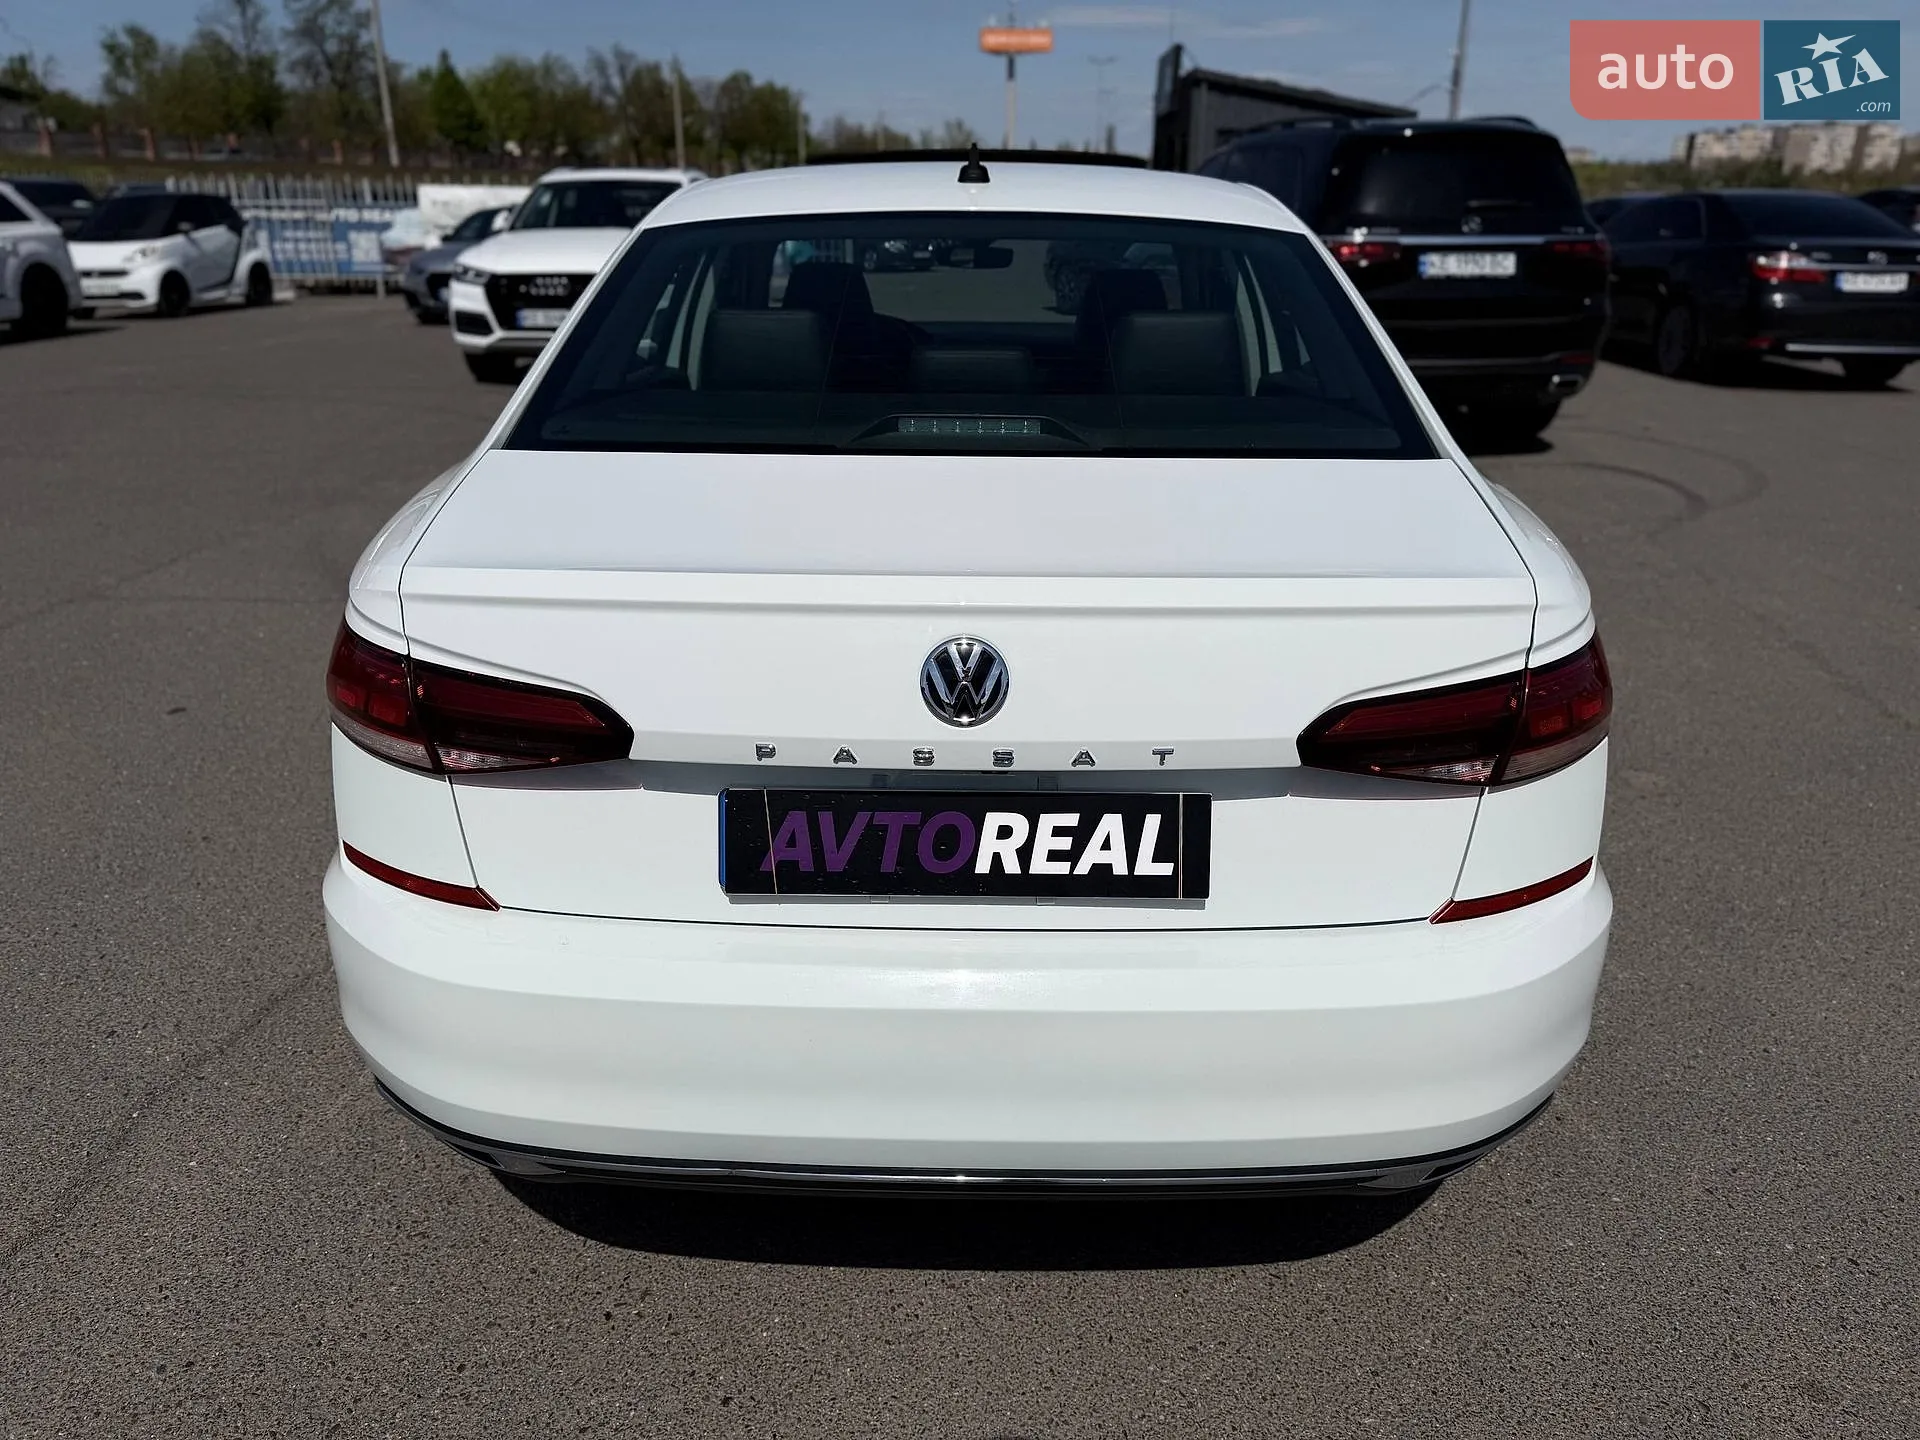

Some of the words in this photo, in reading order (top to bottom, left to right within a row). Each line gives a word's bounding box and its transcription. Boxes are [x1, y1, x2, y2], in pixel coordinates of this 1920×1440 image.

[919, 636, 1010, 728] VW
[755, 743, 1175, 768] PASSAT
[759, 811, 1175, 875] AVTOREAL
